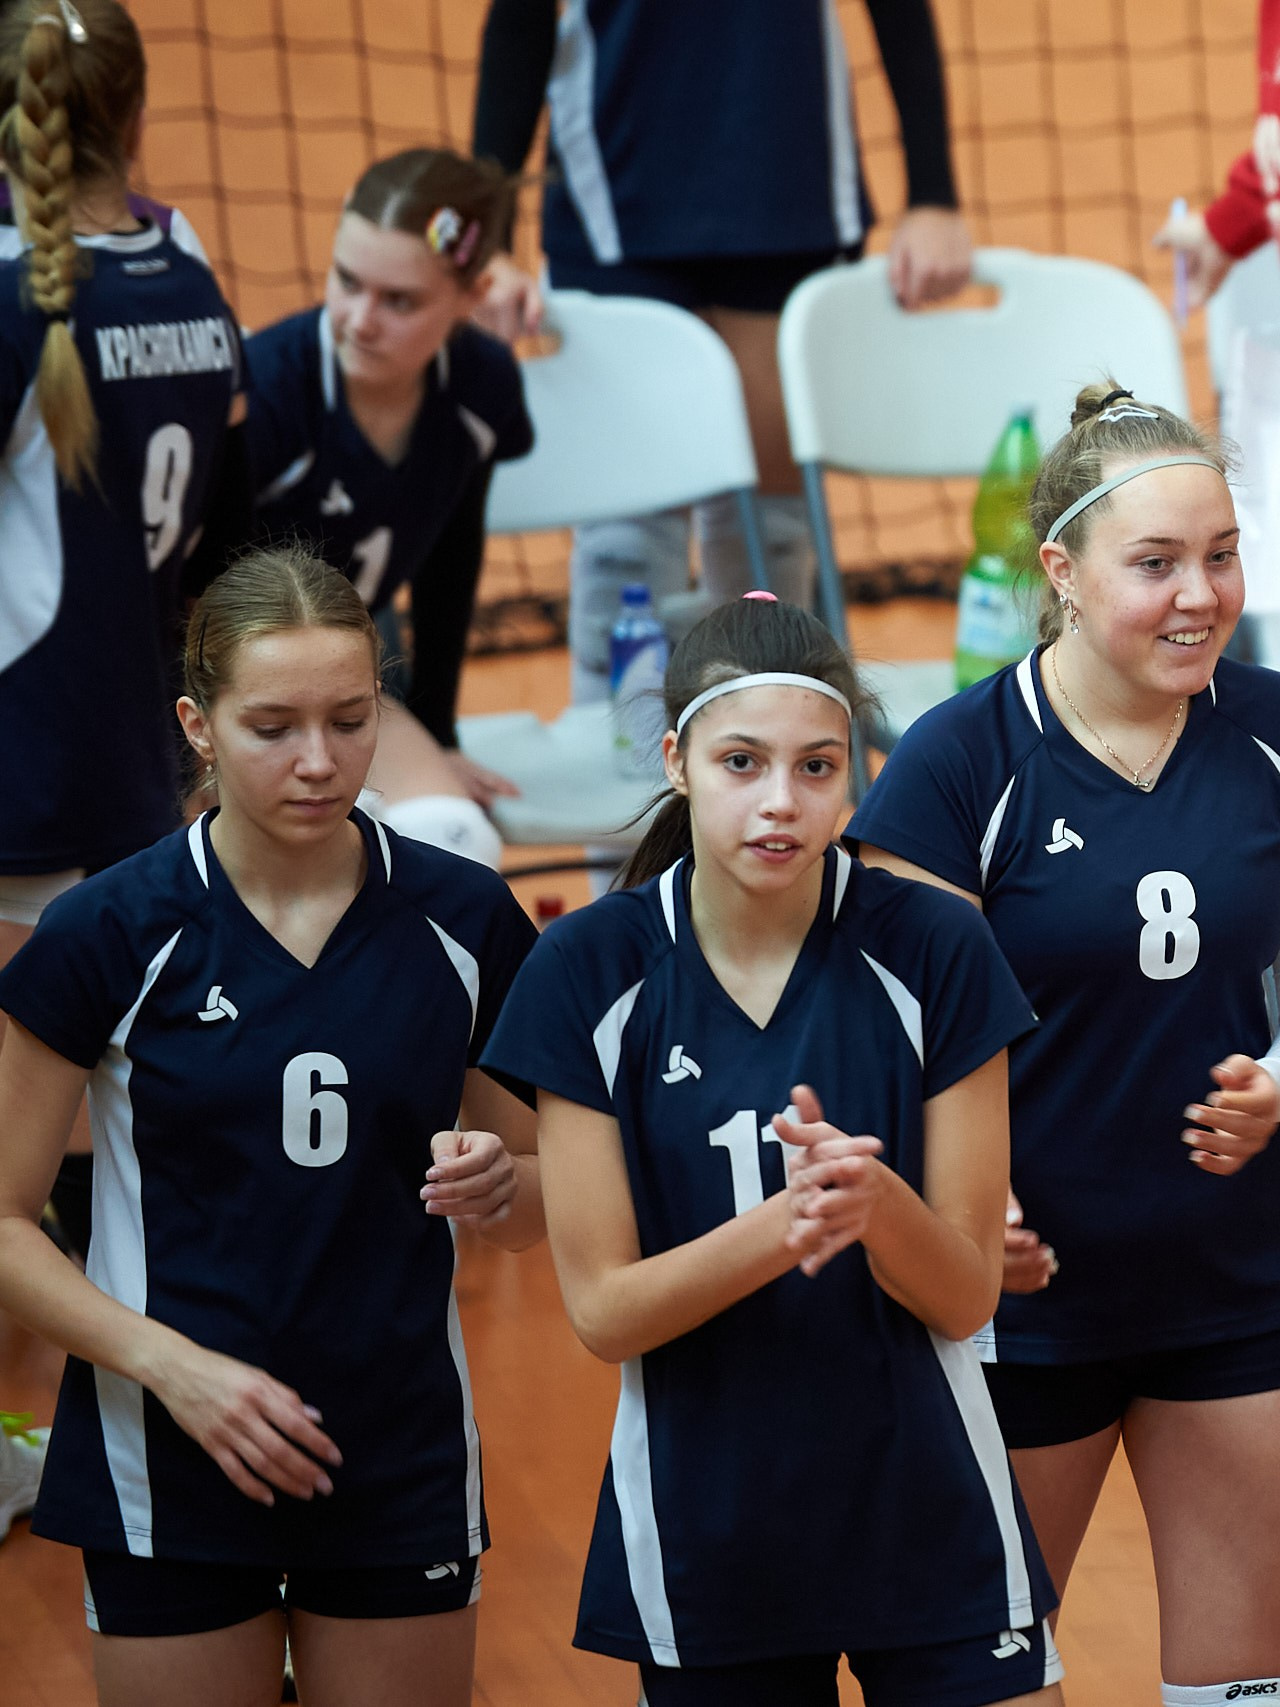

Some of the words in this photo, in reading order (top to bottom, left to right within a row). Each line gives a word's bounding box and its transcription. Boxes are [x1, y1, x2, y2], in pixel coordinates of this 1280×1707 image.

[141, 422, 193, 573] 9
[1136, 870, 1200, 980] 8
[282, 1051, 349, 1168] 6
[1241, 1682, 1279, 1696] asics
